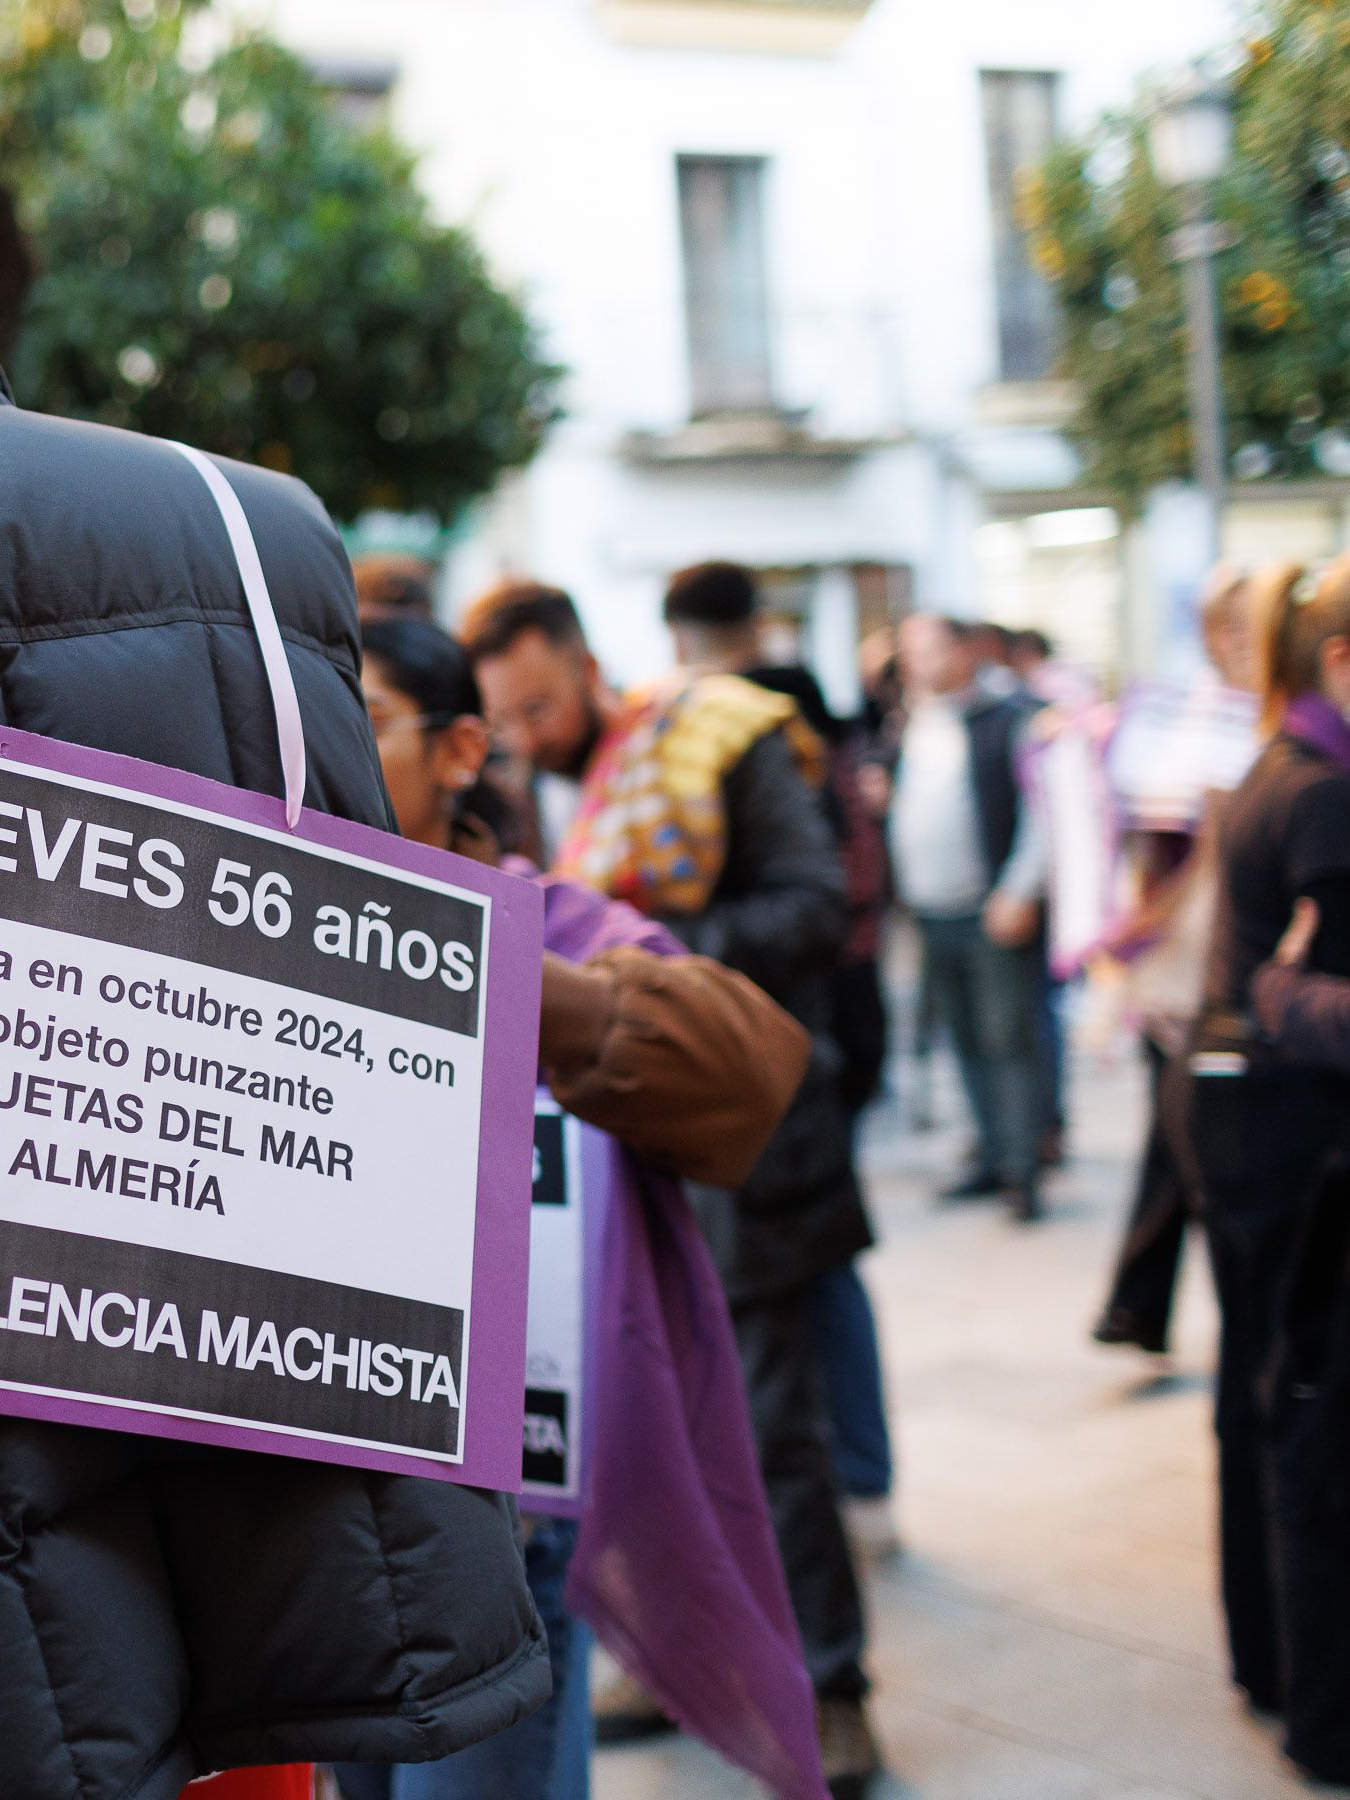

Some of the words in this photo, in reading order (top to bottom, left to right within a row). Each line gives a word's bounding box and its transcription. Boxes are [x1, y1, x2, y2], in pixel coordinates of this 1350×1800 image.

[209, 858, 292, 938] 56
[314, 902, 474, 991] años
[29, 960, 82, 995] en
[100, 975, 262, 1036] octubre
[275, 1009, 373, 1073] 2024,
[389, 1048, 454, 1087] con
[144, 1046, 333, 1114] punzante
[8, 1139, 225, 1215] ALMERÍA
[159, 1102, 244, 1156] DEL
[260, 1125, 353, 1181] MAR
[197, 1310, 460, 1408] MACHISTA
